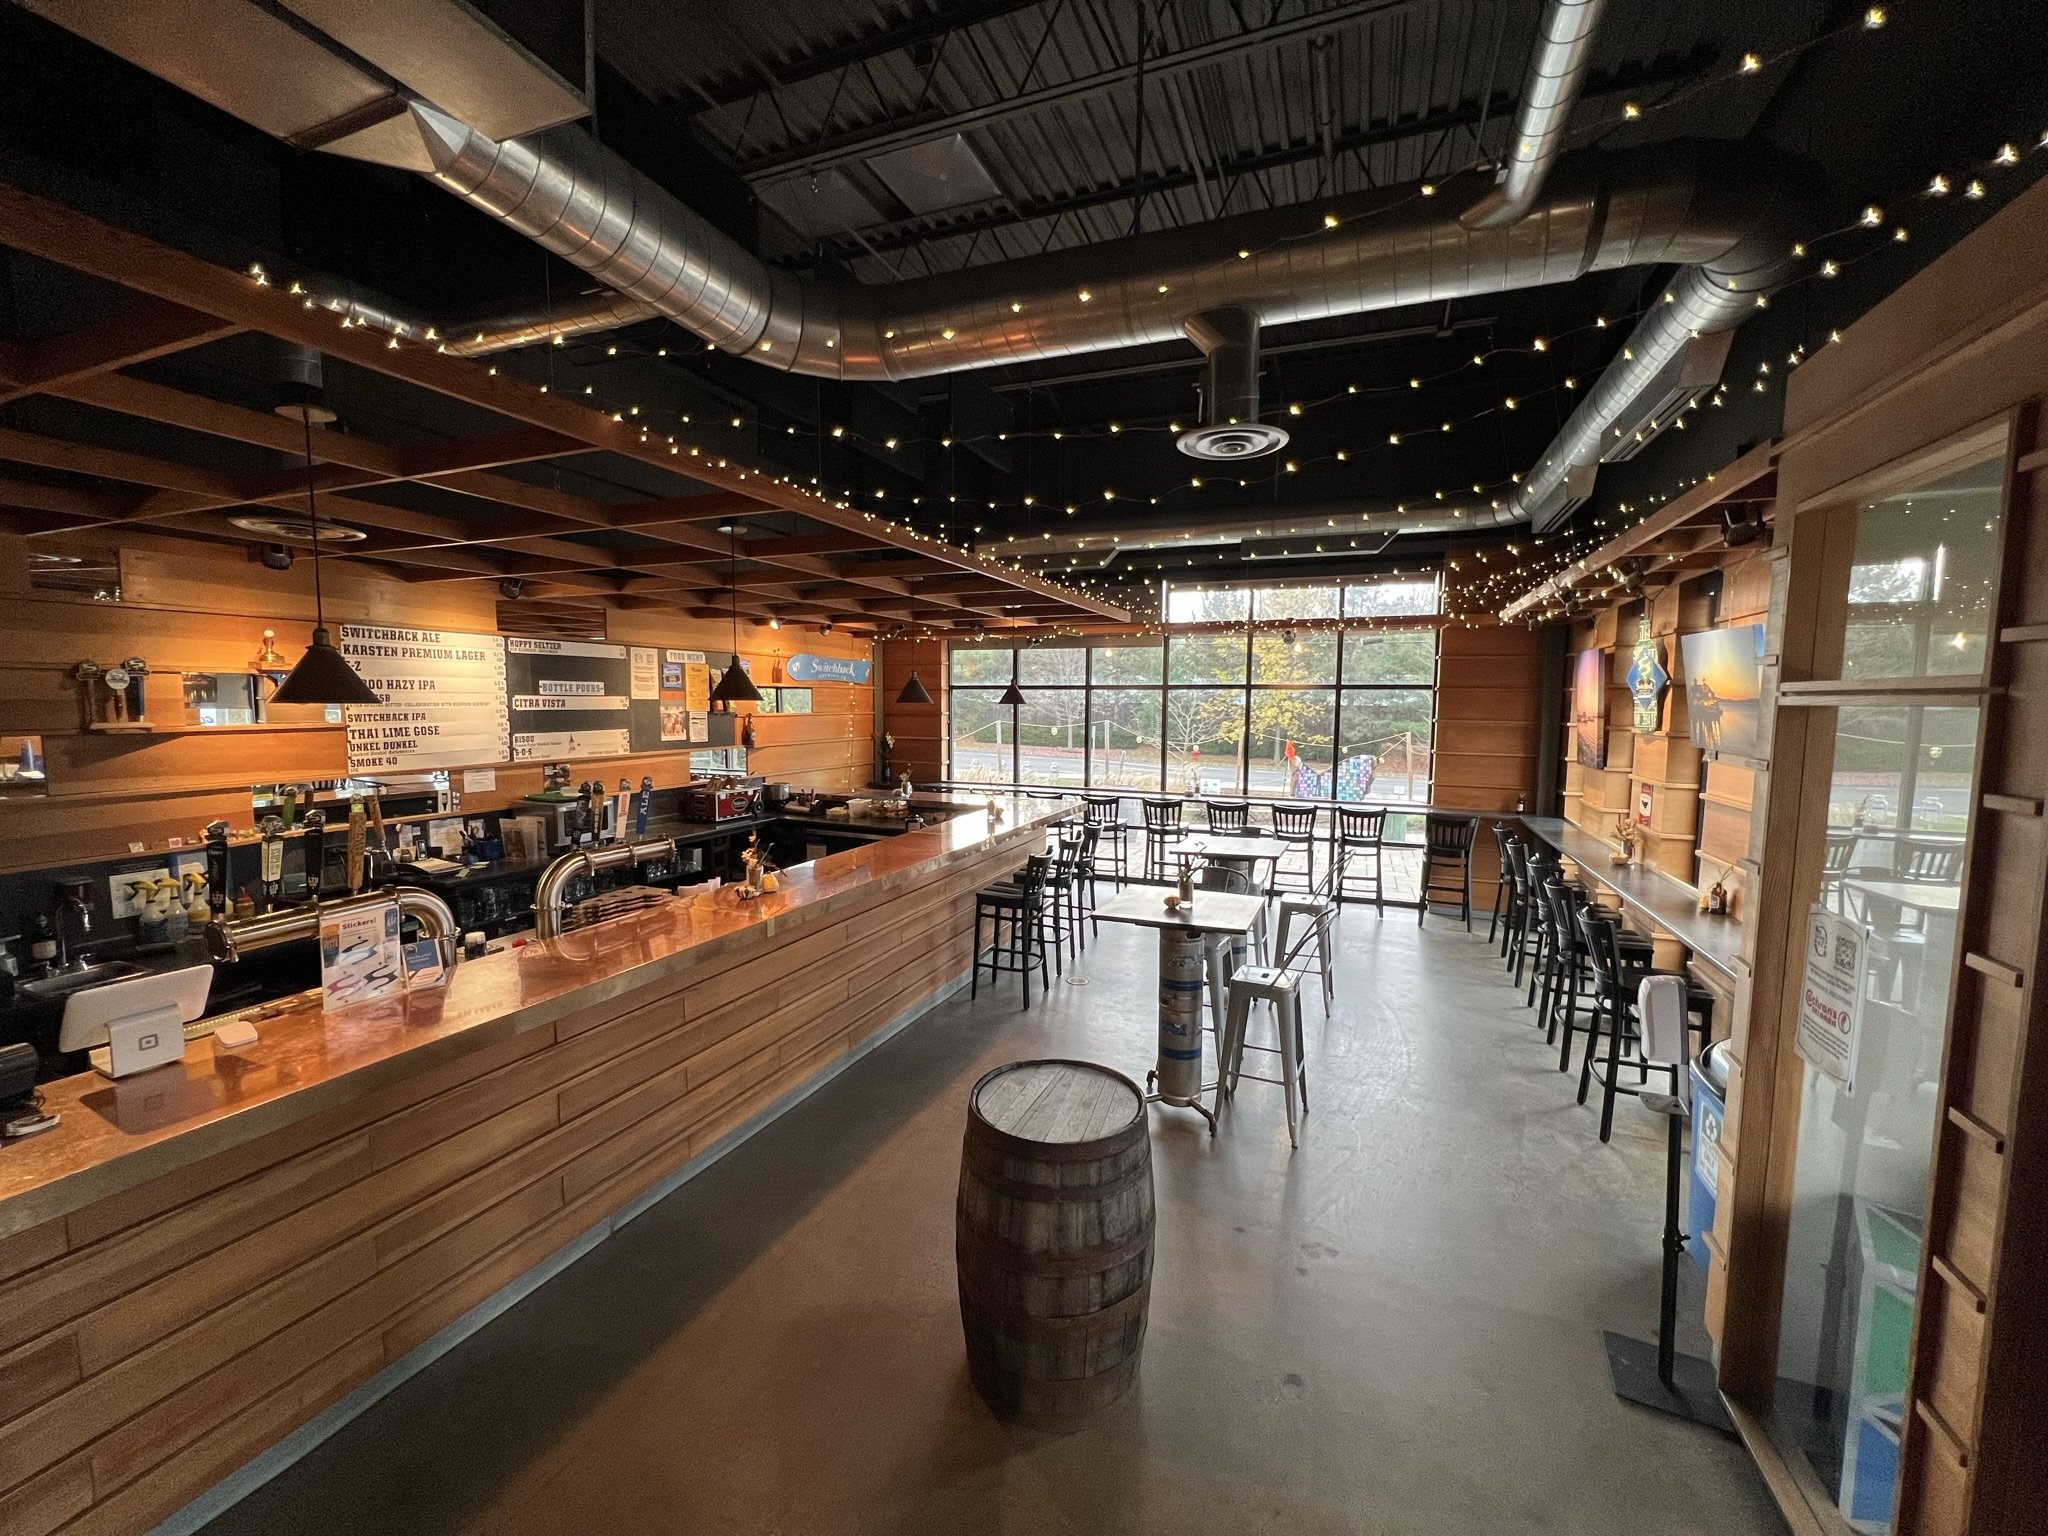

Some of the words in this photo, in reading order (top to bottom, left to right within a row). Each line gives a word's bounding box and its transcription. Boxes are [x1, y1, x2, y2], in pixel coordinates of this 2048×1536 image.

[342, 627, 418, 642] SWITCHBACK
[422, 632, 441, 643] ALE
[510, 640, 532, 649] HOPPY
[534, 642, 562, 650] SELTZER
[343, 644, 398, 658] KARSTEN
[402, 647, 453, 660] PREMIUM
[456, 651, 486, 661] LAGER
[811, 659, 856, 677] Switchback
[387, 680, 415, 690] HAZY
[419, 680, 435, 690] IPA
[541, 683, 573, 693] BOTTLE
[576, 684, 601, 693] POURS
[514, 699, 539, 708] CITRA
[542, 699, 566, 708] VISTA
[348, 713, 409, 723] SWITCHBACK
[412, 712, 426, 721] IPA
[349, 727, 379, 740] THAI
[383, 726, 410, 738] LIME
[414, 725, 440, 737] GOSE
[350, 741, 381, 752] UNKEL
[383, 740, 418, 750] DUNKEL
[350, 757, 384, 768] SMOKE
[386, 756, 398, 766] 40
[640, 791, 650, 815] ALE
[342, 917, 377, 930] Stickers!
